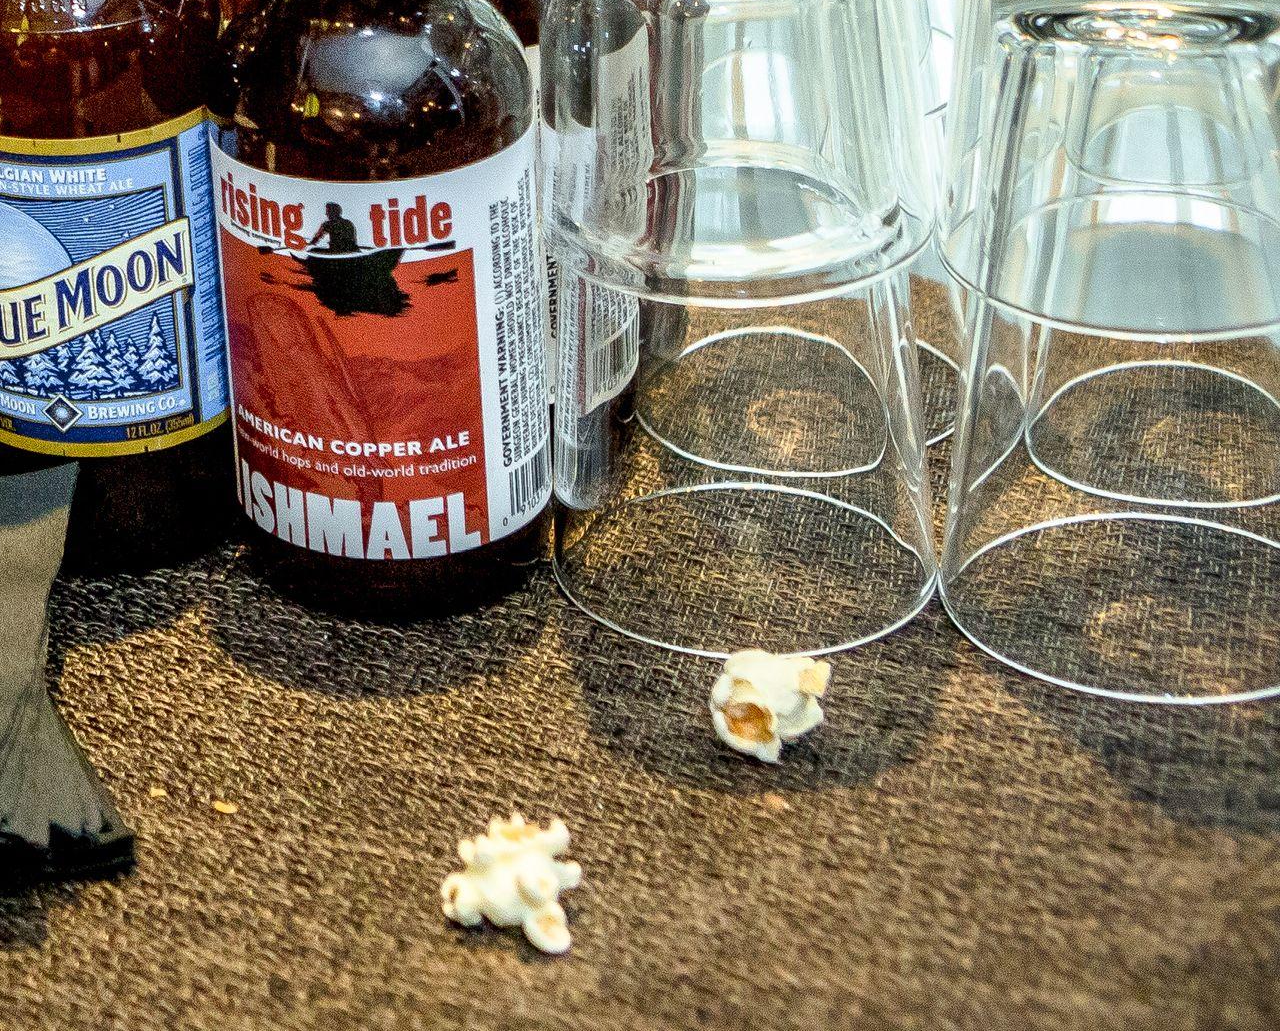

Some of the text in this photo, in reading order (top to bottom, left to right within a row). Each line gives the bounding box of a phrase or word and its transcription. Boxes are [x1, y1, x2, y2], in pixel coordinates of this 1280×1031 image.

[49, 167, 108, 184] WHITE
[54, 182, 105, 196] WHEAT
[108, 178, 135, 192] ALE
[220, 172, 453, 250] rising tide
[488, 201, 499, 221] THE
[490, 222, 500, 236] TO
[53, 229, 188, 334] MOON
[490, 236, 503, 289] ACCORDING
[495, 307, 508, 377] WARNING:
[500, 196, 523, 462] SURGEON GENERAL WOMEN SHOULD NOT DRINK ALCOHOLIC
[510, 200, 531, 457] BEVERAGES DURING PREGNANCY BECAUSE OF THE RISK OF
[0, 394, 37, 416] MOON
[87, 396, 180, 421] BREWING CO.
[238, 403, 471, 457] AMERICAN COPPER ALE
[498, 378, 513, 468] GOVERNMENT
[126, 426, 138, 439] 12
[282, 448, 478, 479] hops and old-world tradition
[240, 457, 483, 561] ISHMAEL
